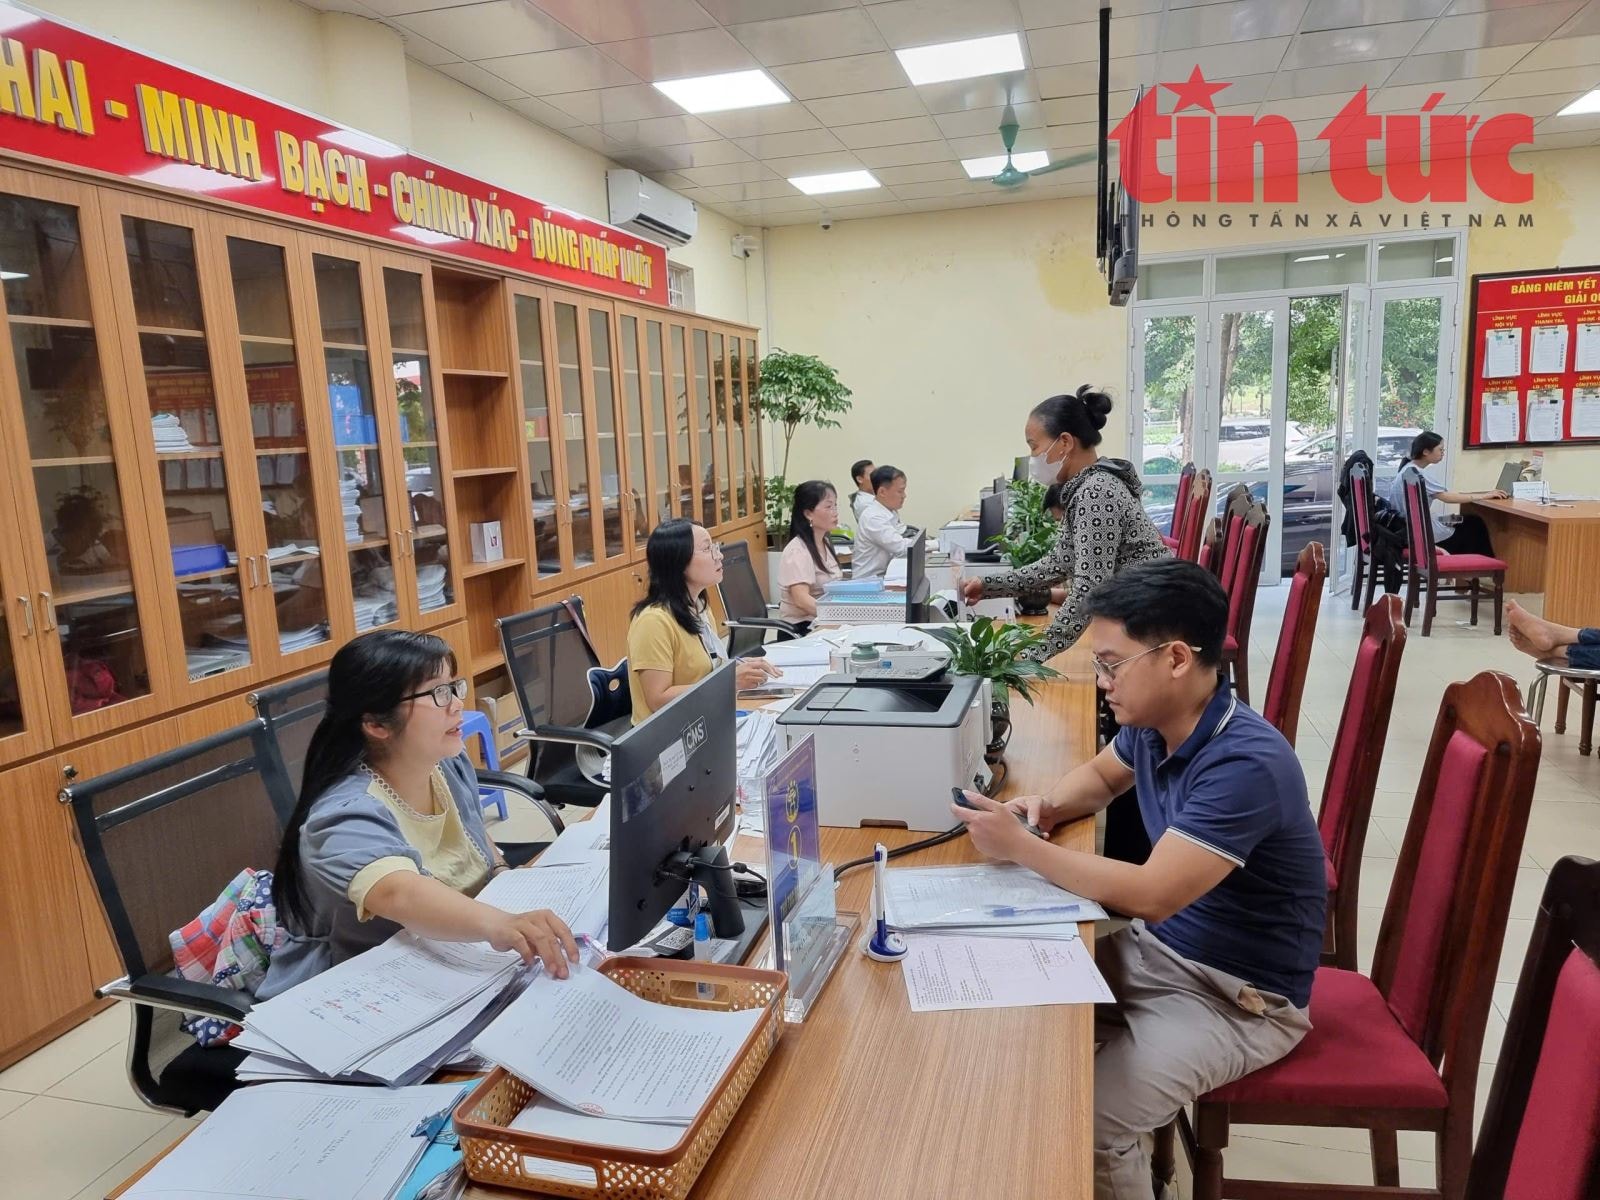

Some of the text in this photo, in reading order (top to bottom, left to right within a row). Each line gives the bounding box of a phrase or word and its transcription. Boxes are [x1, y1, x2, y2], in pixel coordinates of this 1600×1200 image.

[136, 83, 263, 182] MINH
[275, 129, 372, 213] BẠCH
[390, 170, 474, 241] CHÍNH
[472, 192, 517, 253] XÁC
[529, 210, 580, 270] ĐÚNG
[579, 231, 620, 279] PHÁP
[619, 244, 653, 295] LUẬT
[1511, 276, 1598, 294] BẢNG NIÊM YẾT
[1564, 290, 1587, 304] GIẢI
[686, 723, 705, 749] CMS
[789, 831, 799, 862] 1
